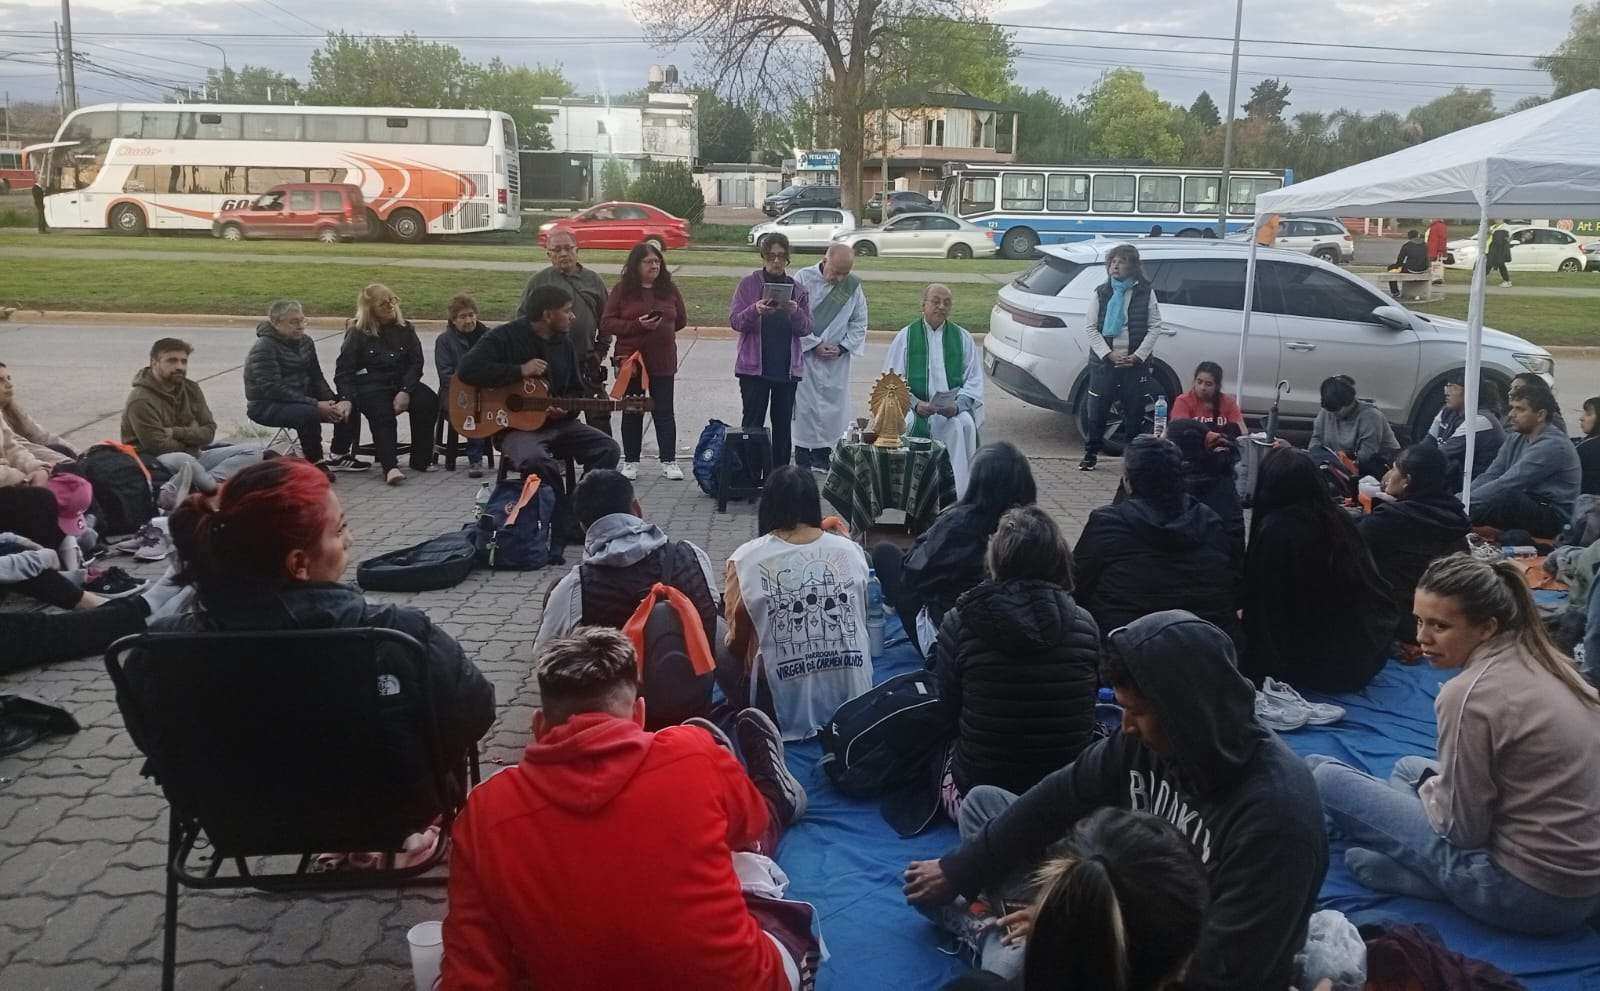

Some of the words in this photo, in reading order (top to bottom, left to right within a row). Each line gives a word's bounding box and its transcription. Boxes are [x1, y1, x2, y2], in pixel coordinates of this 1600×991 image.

[805, 650, 838, 661] PARROQUIA
[776, 662, 805, 680] VIRGEN
[816, 657, 842, 669] CARMEN
